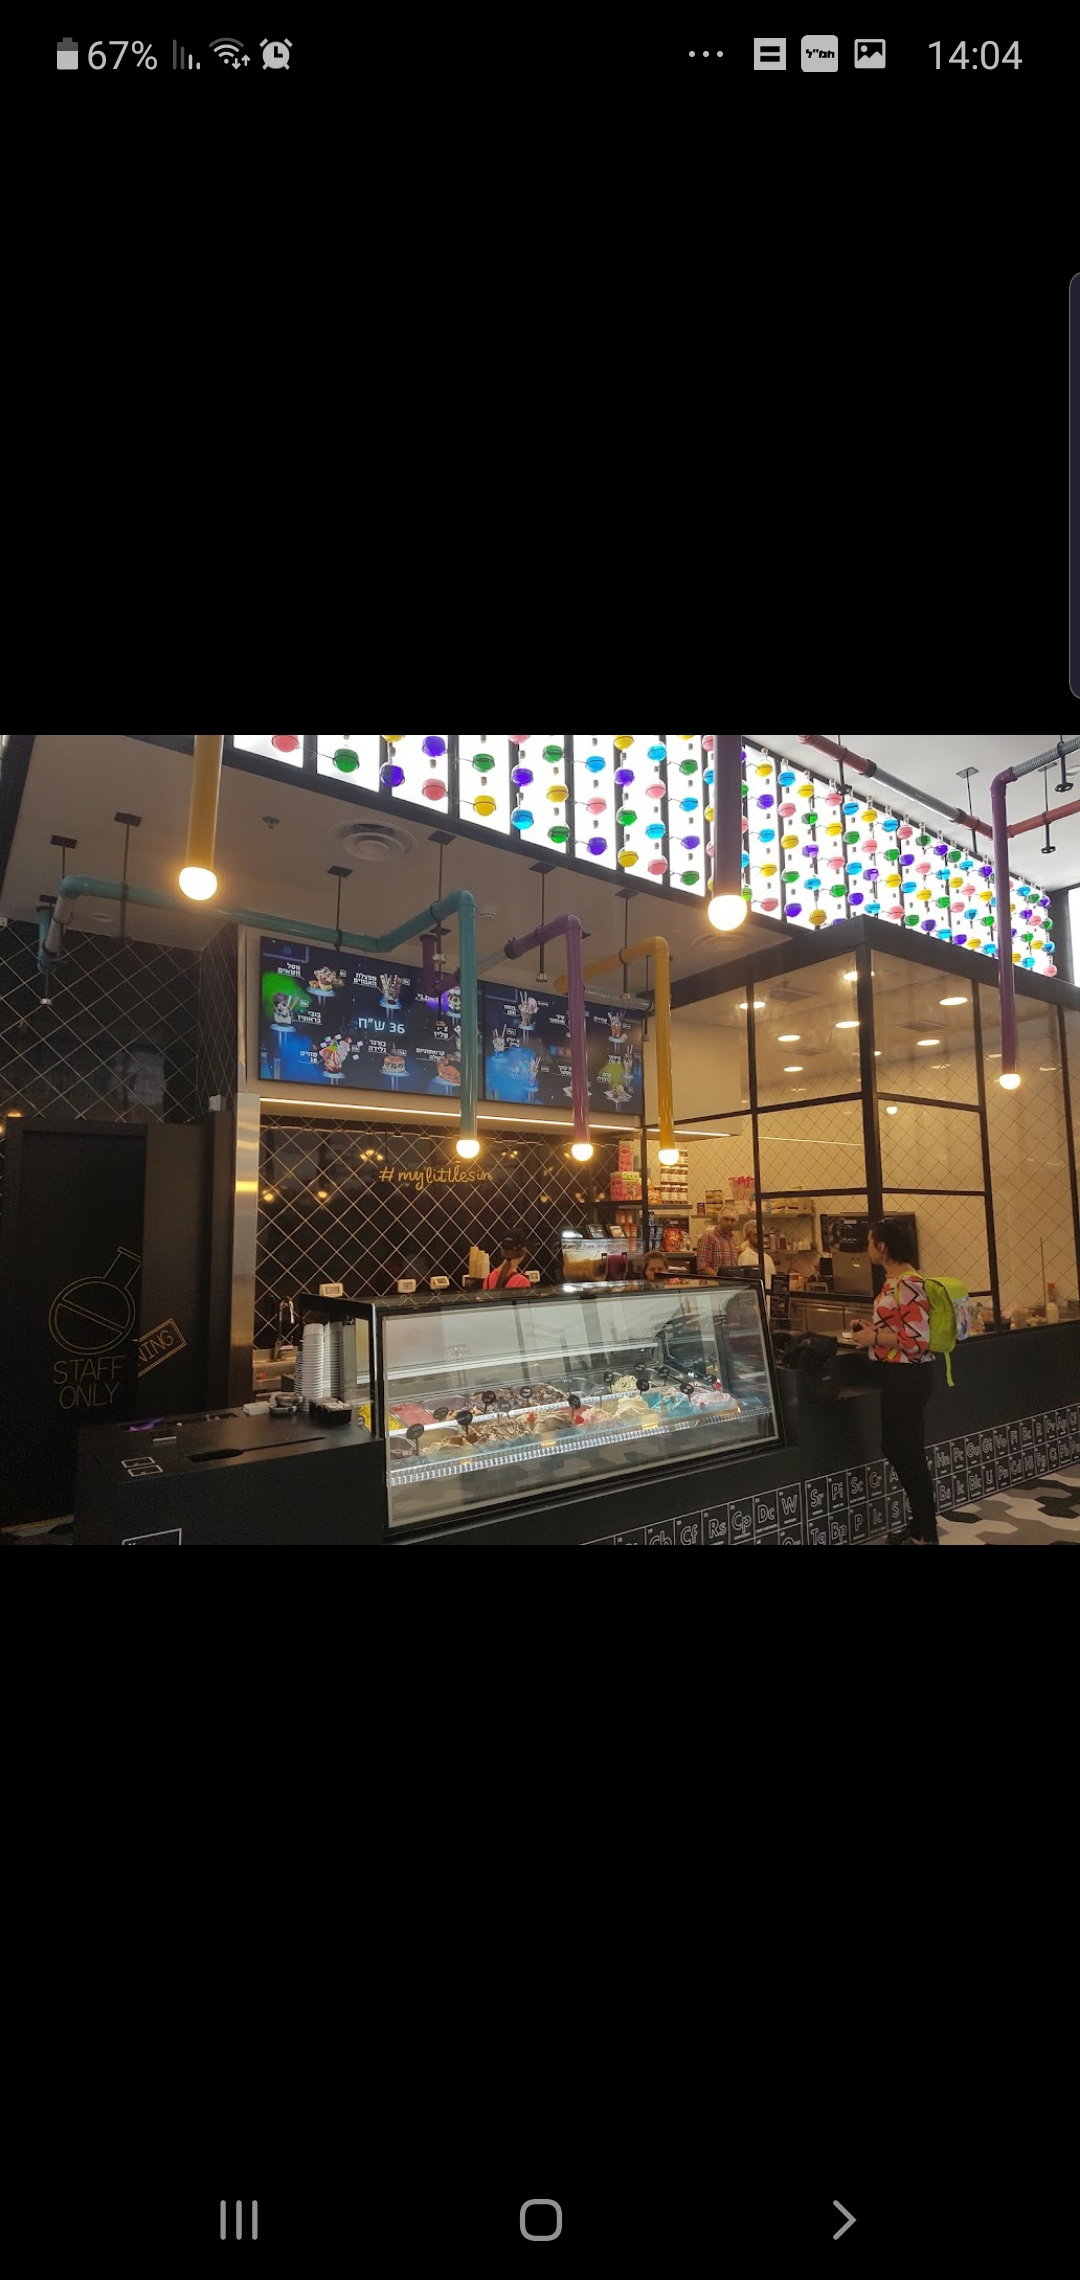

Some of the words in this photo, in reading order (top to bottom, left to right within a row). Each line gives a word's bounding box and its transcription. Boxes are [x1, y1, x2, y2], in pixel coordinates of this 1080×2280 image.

[358, 1017, 386, 1031] ש"ח
[389, 1022, 405, 1034] 36
[53, 1355, 126, 1385] STAFF
[59, 1381, 120, 1410] ONLY
[810, 1488, 824, 1507] Sr
[831, 1481, 843, 1501] Pi
[850, 1476, 863, 1494] Sc
[680, 1523, 698, 1545] Cf
[708, 1518, 727, 1539] Rs
[731, 1510, 752, 1535] Cp
[757, 1504, 775, 1524] Dc
[781, 1494, 798, 1516] W
[830, 1521, 848, 1542] Bp
[854, 1513, 863, 1532] P
[891, 1500, 900, 1519] S
